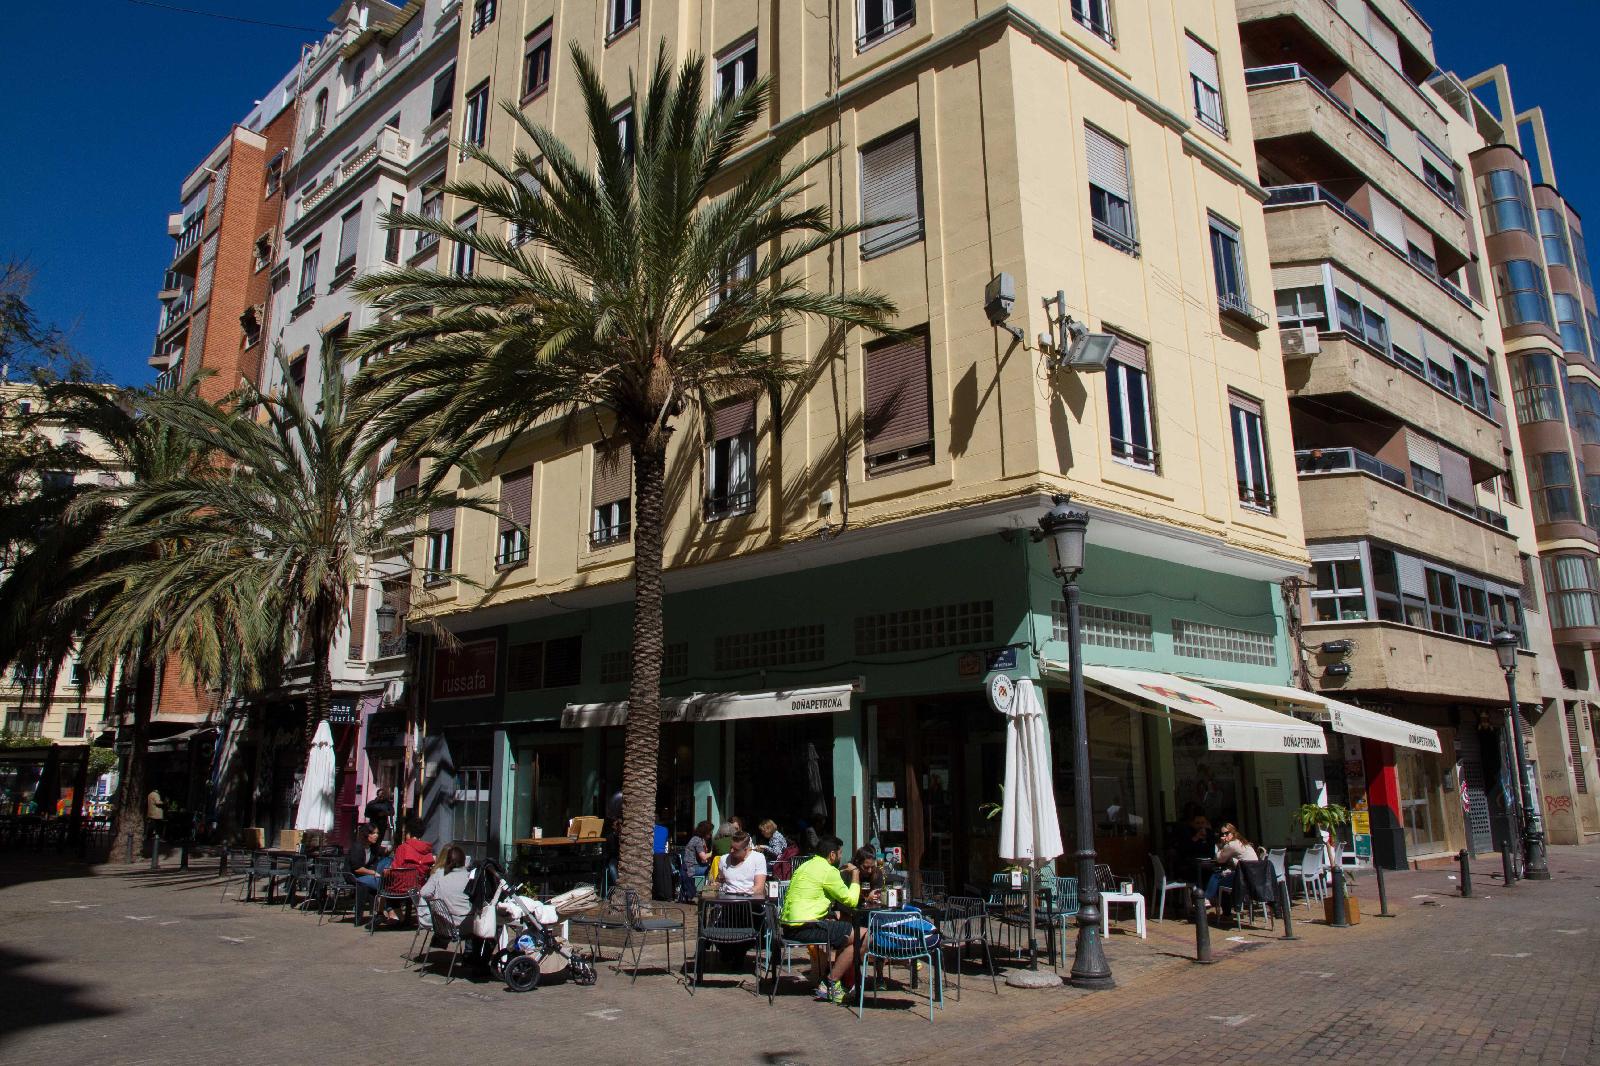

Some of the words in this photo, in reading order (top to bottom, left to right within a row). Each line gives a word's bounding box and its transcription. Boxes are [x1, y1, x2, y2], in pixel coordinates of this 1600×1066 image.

[443, 668, 486, 694] russafa
[791, 697, 843, 711] DOÑAPETRONA
[1283, 734, 1321, 749] DOÑAPETRONA
